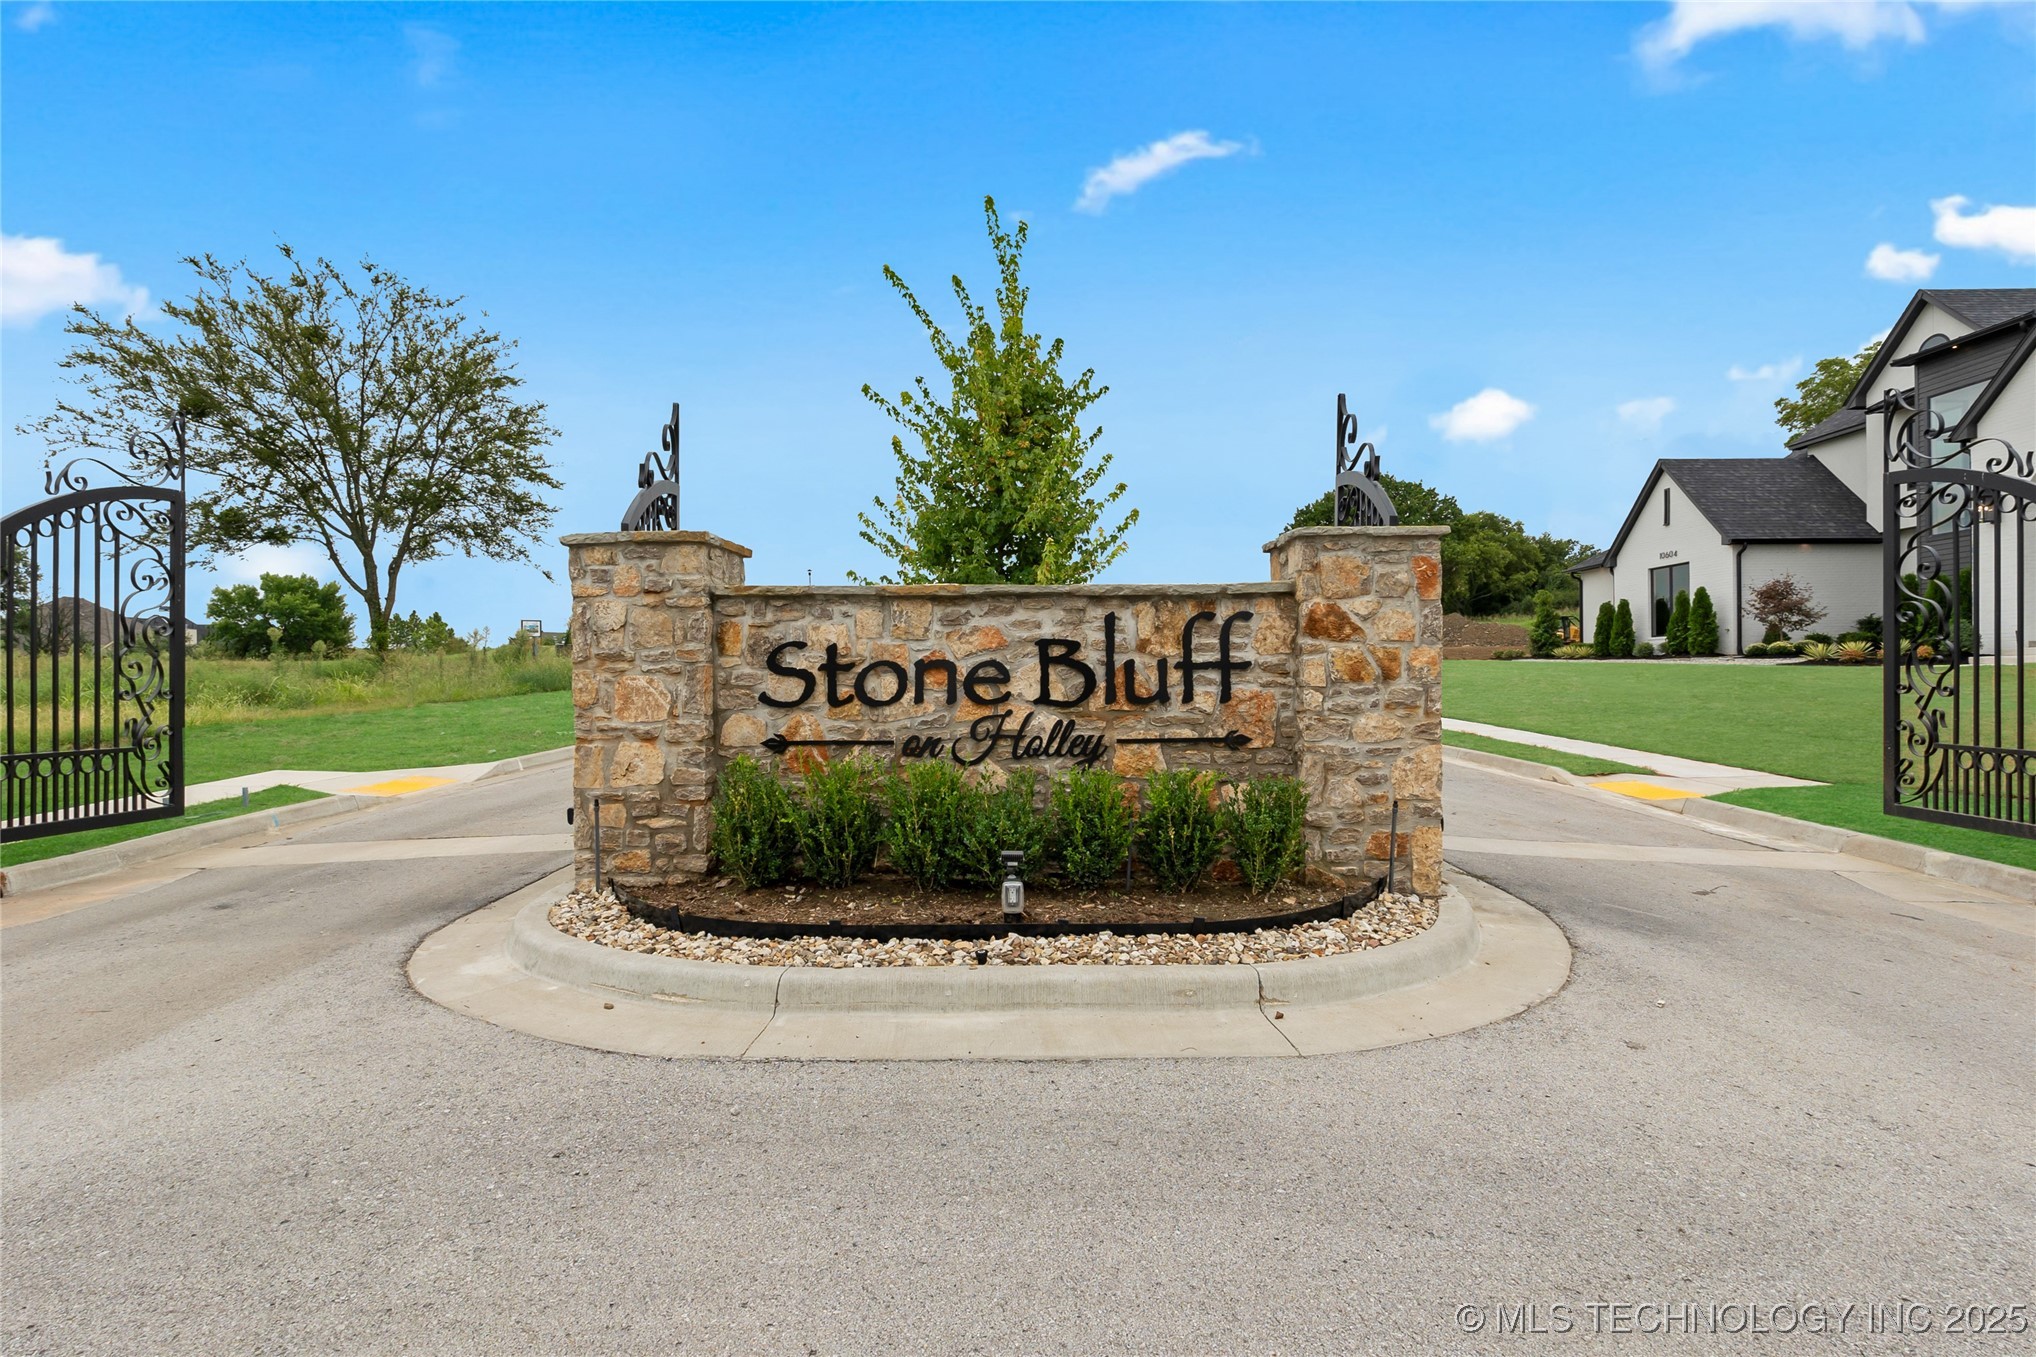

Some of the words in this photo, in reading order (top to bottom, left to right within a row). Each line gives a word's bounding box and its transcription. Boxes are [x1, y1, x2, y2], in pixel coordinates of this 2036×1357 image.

[759, 641, 1010, 708] Stone
[1034, 611, 1254, 707] Bluff
[902, 732, 943, 758] on
[951, 709, 1108, 774] Holley
